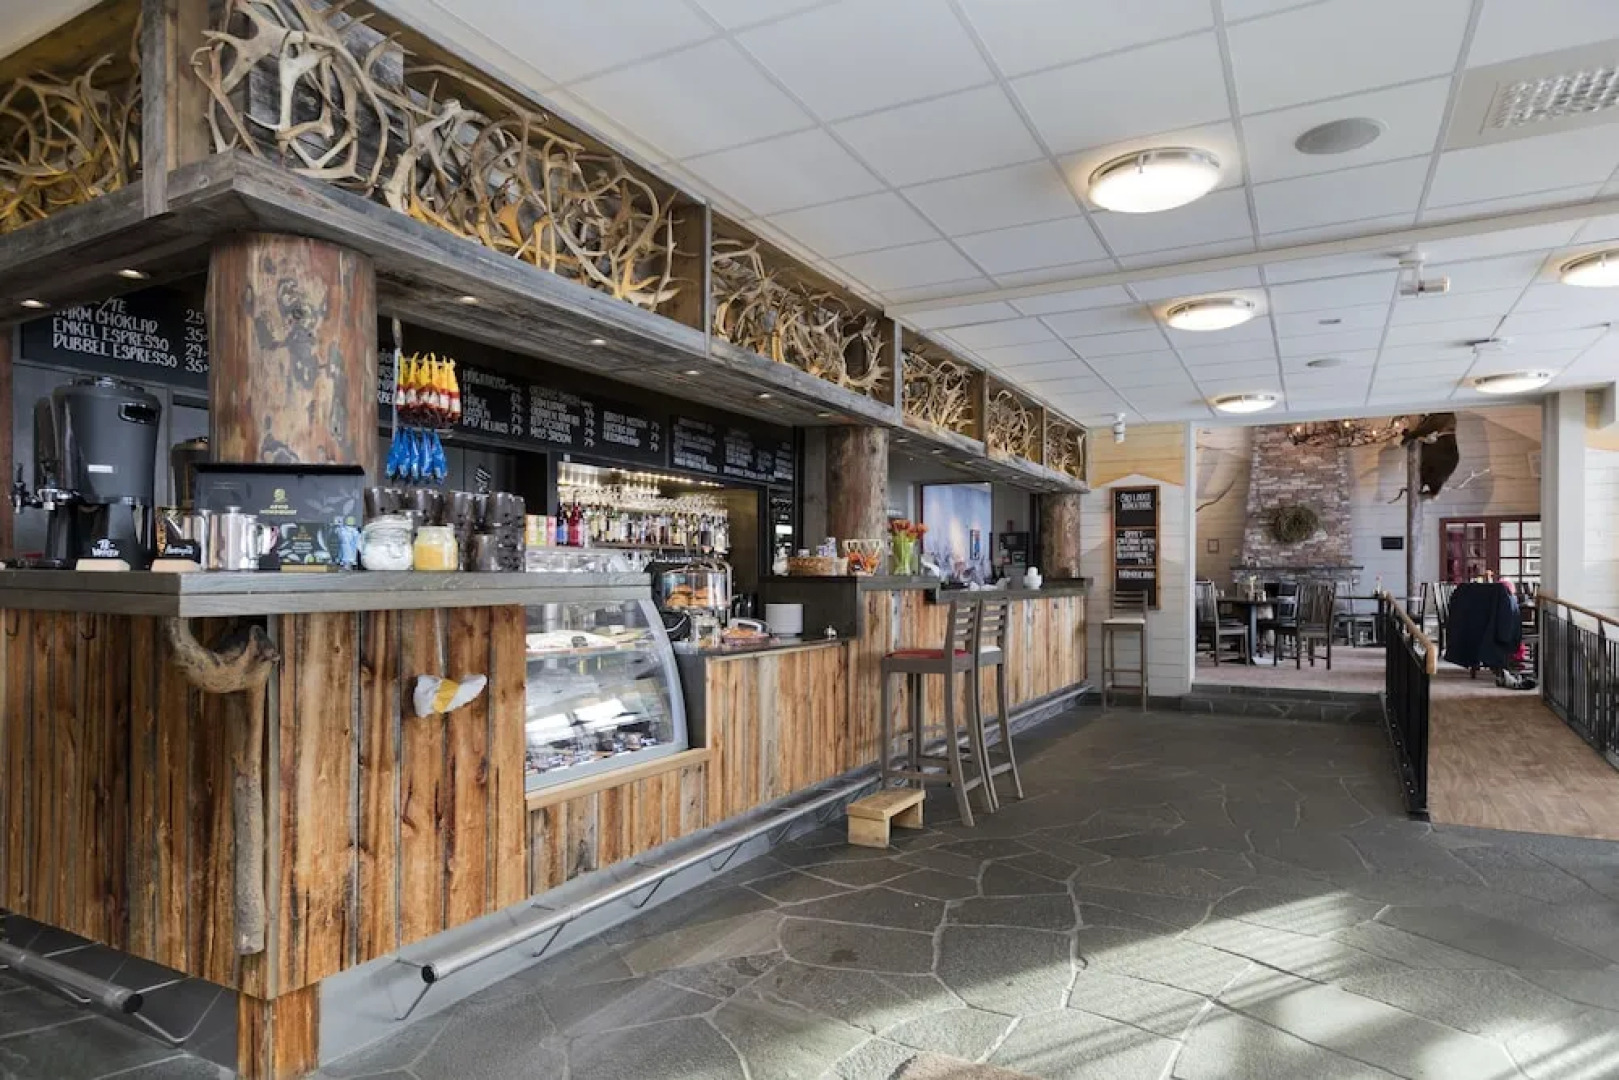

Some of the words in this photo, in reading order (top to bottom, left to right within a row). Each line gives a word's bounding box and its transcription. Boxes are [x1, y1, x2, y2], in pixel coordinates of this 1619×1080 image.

[53, 317, 98, 339] ENKEL
[102, 326, 169, 351] ESPRESSO
[95, 310, 158, 333] CHOKLAD
[53, 333, 110, 356] DUBBEL
[113, 344, 177, 369] ESPRESSO
